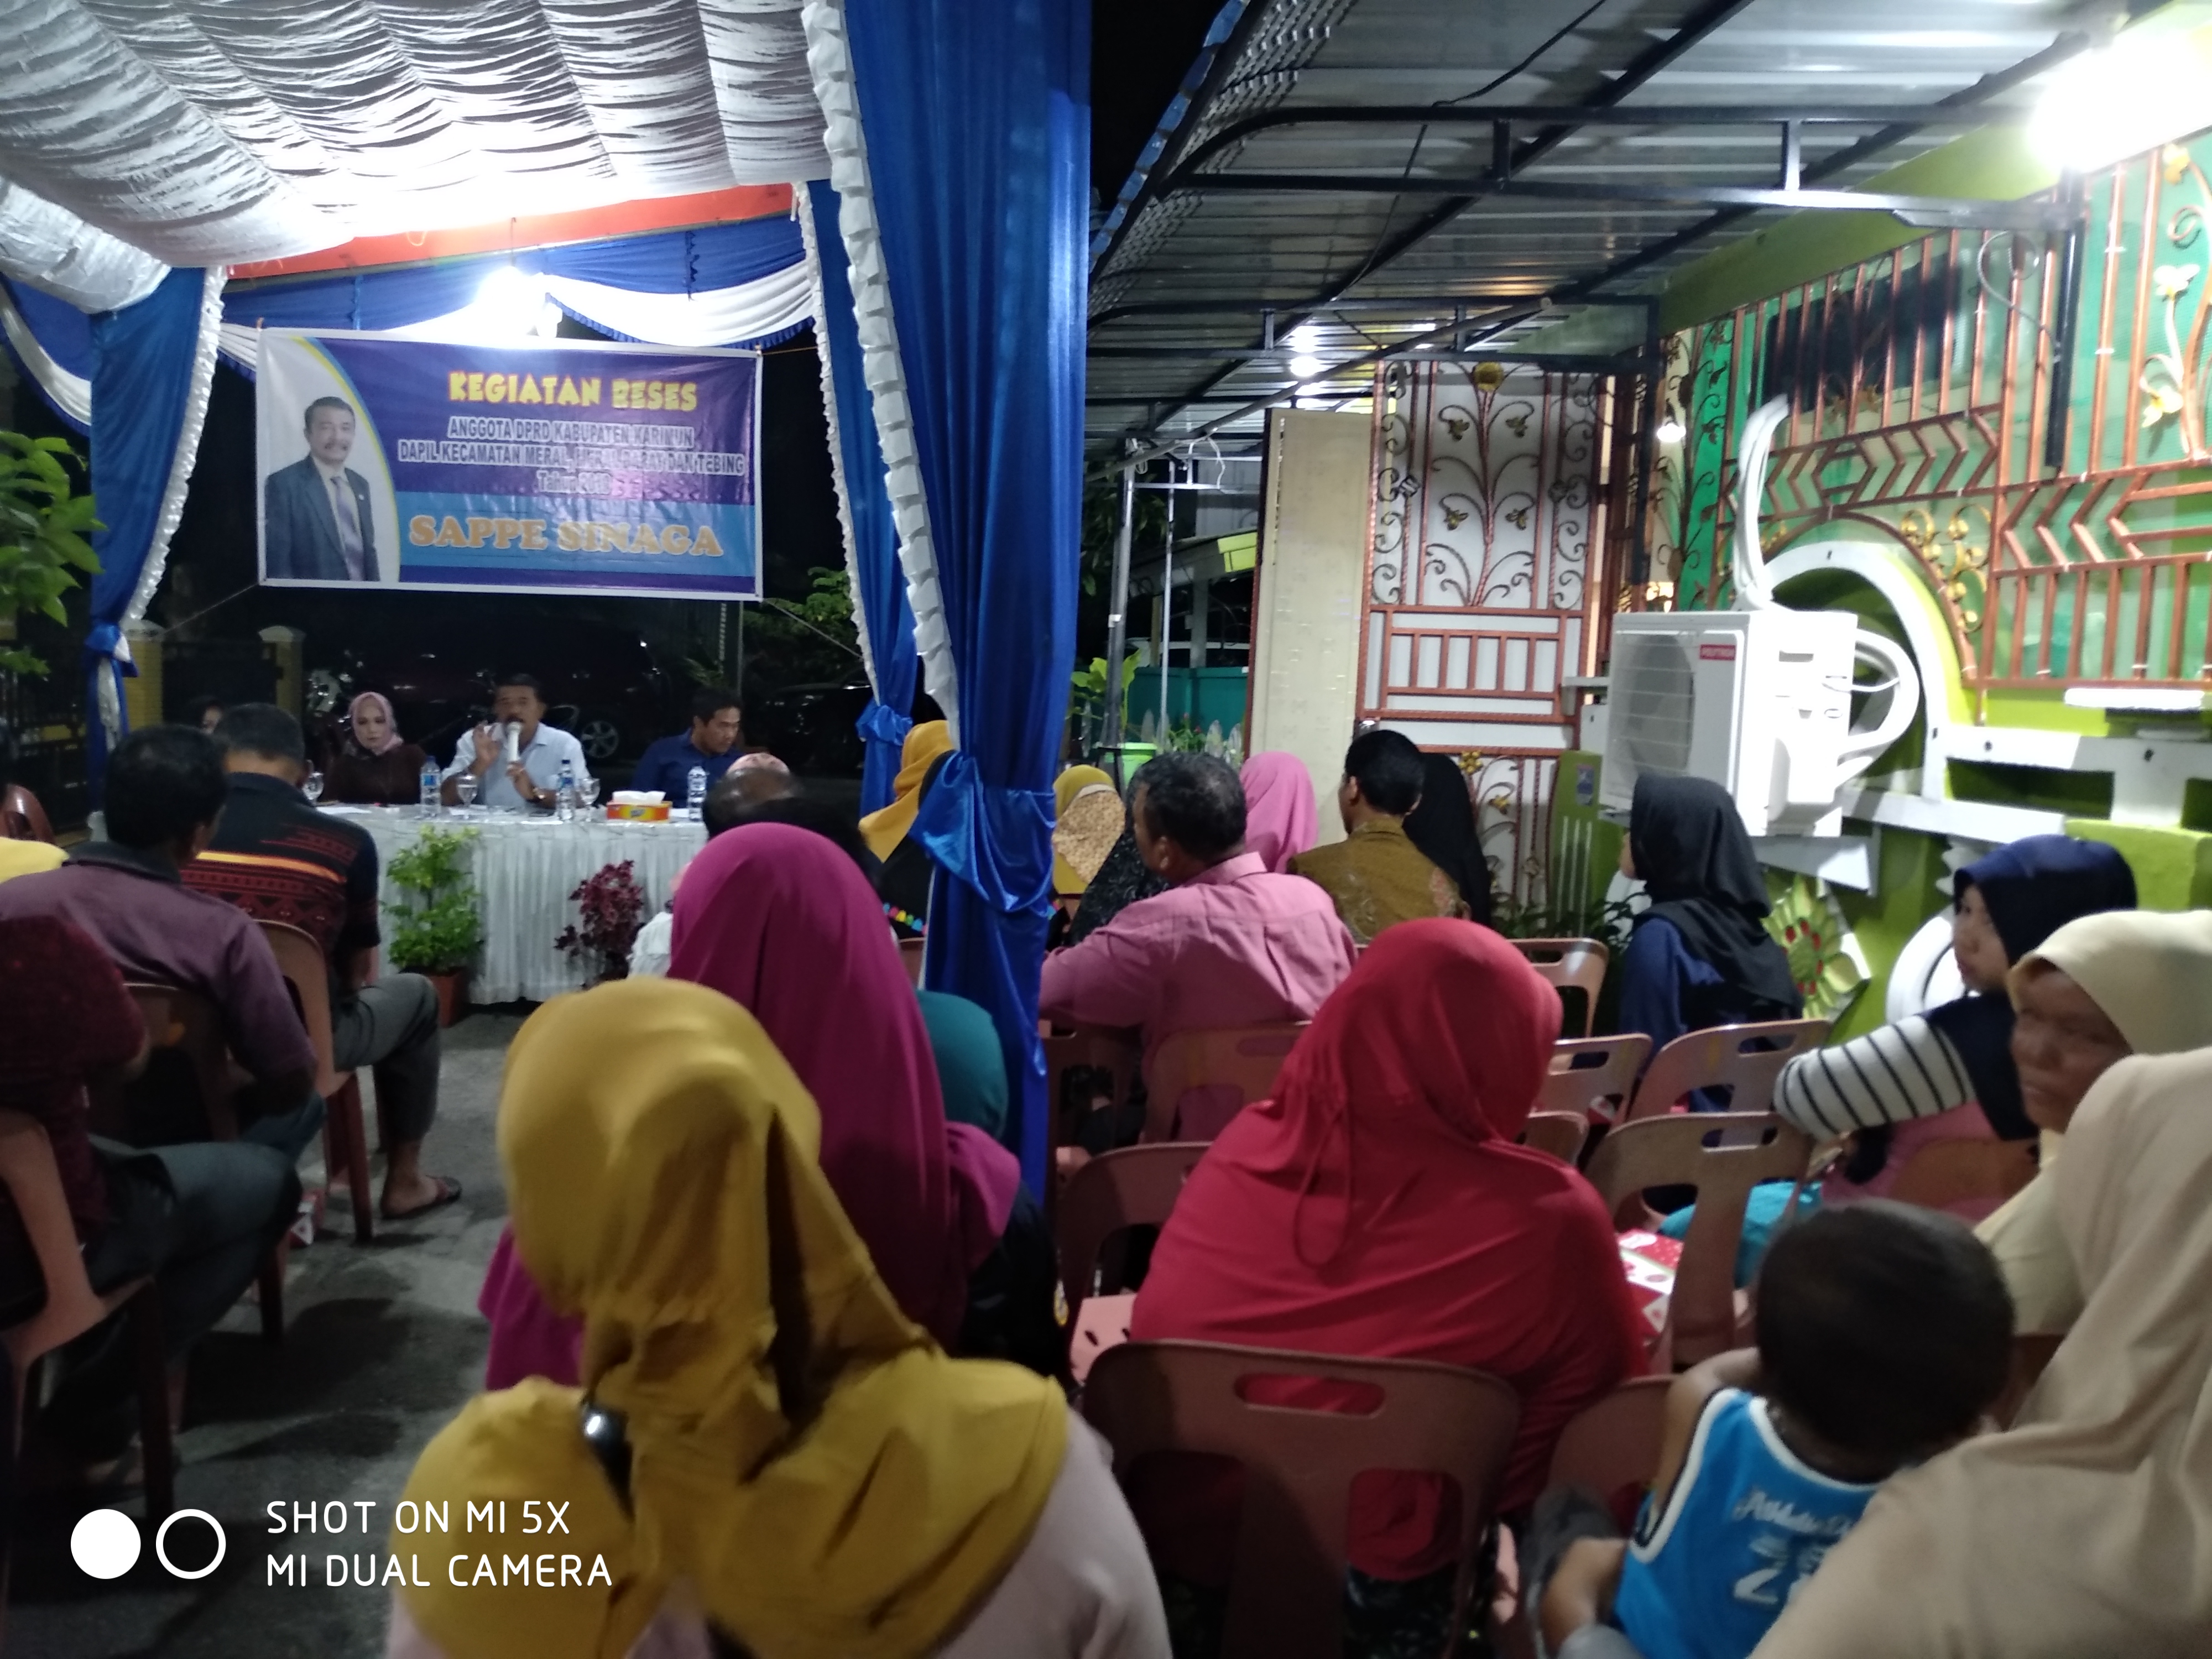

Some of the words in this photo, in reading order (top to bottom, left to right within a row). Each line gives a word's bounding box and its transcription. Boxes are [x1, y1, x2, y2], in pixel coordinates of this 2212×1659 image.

[448, 371, 602, 407] KEGIATAN
[611, 378, 697, 411] RESES
[448, 416, 513, 440] ANGGOTA
[514, 419, 551, 442] DPRD
[551, 420, 631, 446] KABUPATEN
[398, 439, 440, 463] DAPIL
[440, 441, 523, 466] KECAMATAN
[409, 515, 549, 551] SAPPE
[555, 521, 724, 557] SINAGA
